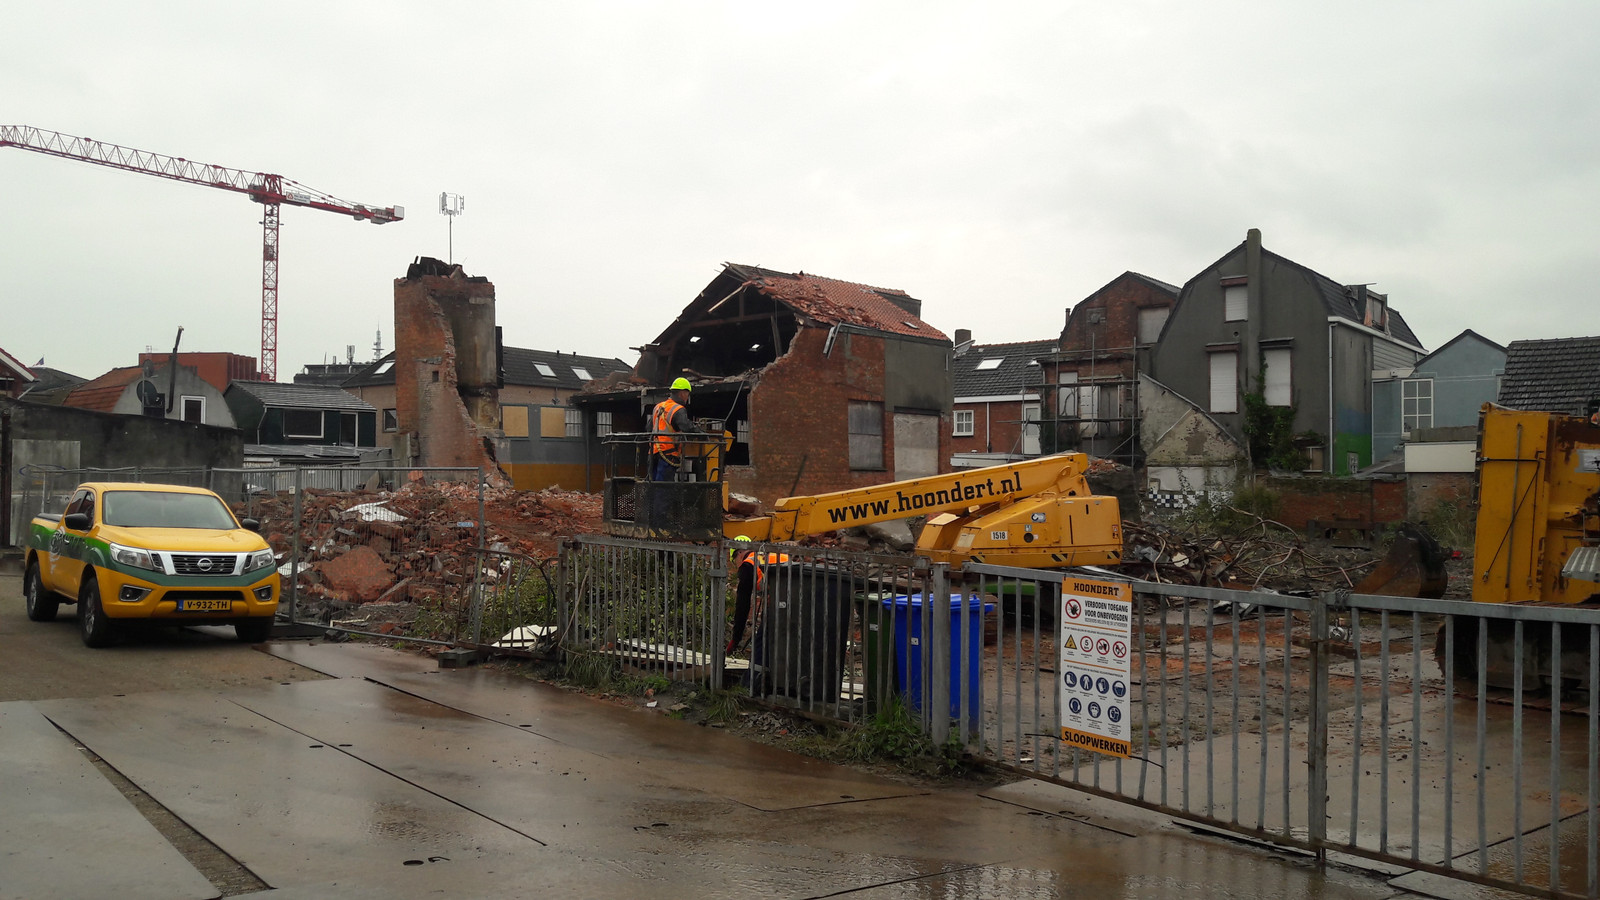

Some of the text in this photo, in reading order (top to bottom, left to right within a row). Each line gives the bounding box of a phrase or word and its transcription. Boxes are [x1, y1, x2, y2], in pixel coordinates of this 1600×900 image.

[828, 471, 1023, 523] www.hoondert.nl
[992, 531, 1006, 540] 1518
[1074, 583, 1119, 596] HOONDERT
[187, 601, 228, 609] V-932-TH
[1085, 600, 1128, 612] VERBODEN TOEGANG
[1085, 610, 1128, 622] VOOR ONBEVOEGDEN
[1064, 731, 1127, 755] SLOOPWERKEN
